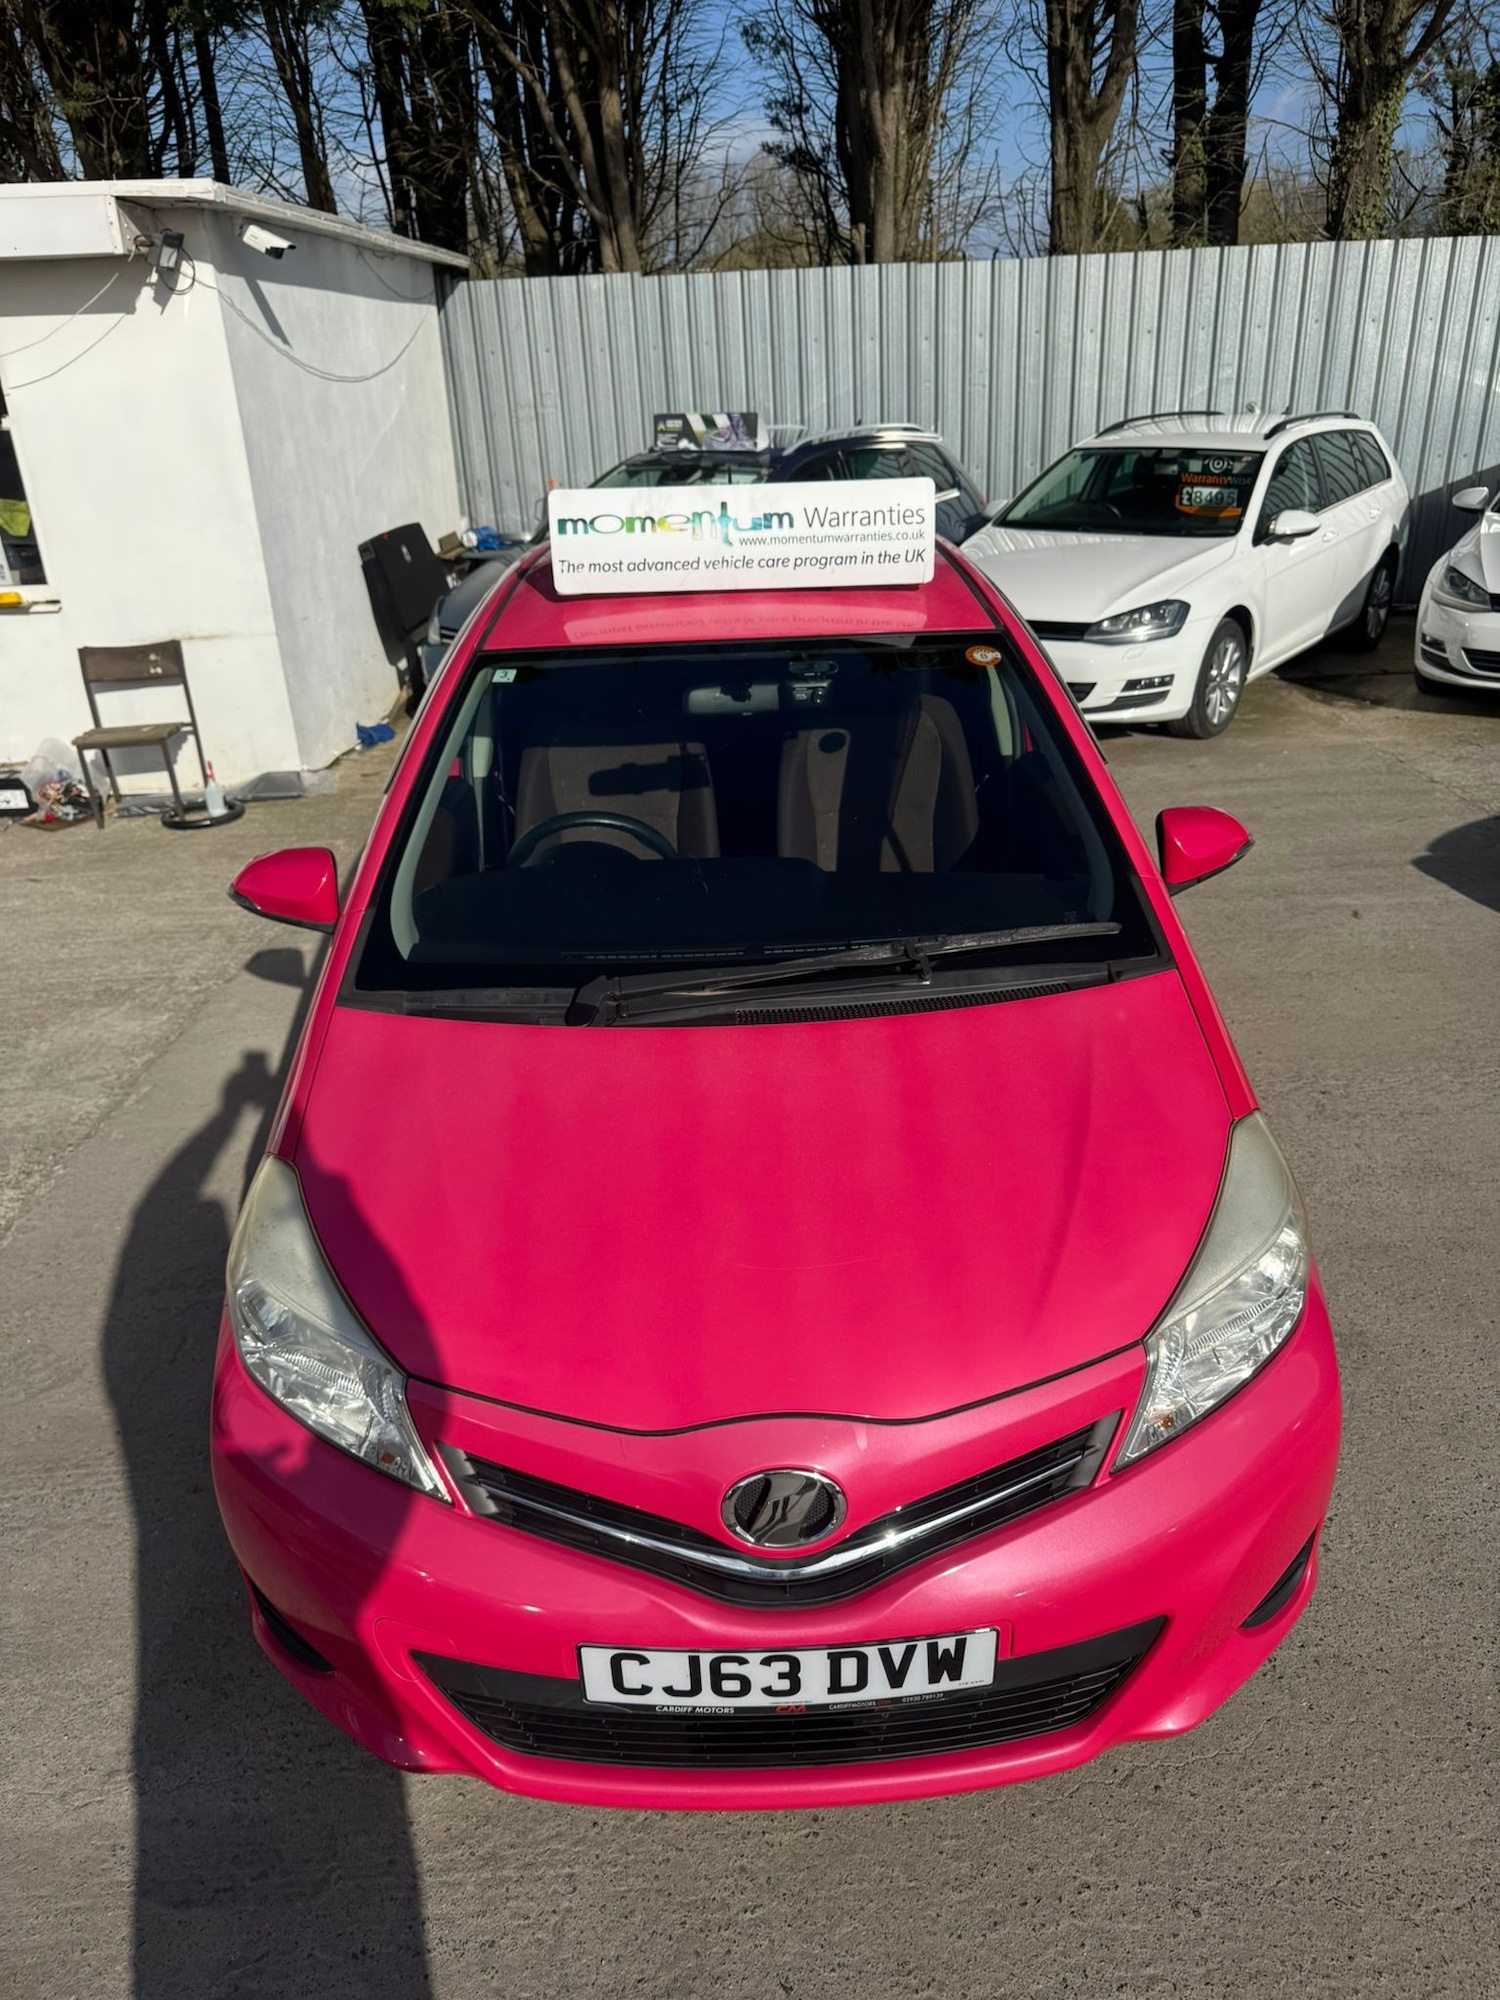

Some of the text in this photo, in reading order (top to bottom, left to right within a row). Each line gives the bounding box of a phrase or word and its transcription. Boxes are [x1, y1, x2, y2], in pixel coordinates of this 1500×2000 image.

[557, 501, 926, 546] momentum Warranties
[738, 529, 925, 546] www.momentumwarranties.co.uk
[559, 548, 926, 574] The most advanced vehicle care program in the UK
[610, 1637, 967, 1698] CJ63 DVW
[695, 1706, 735, 1714] MOTORS
